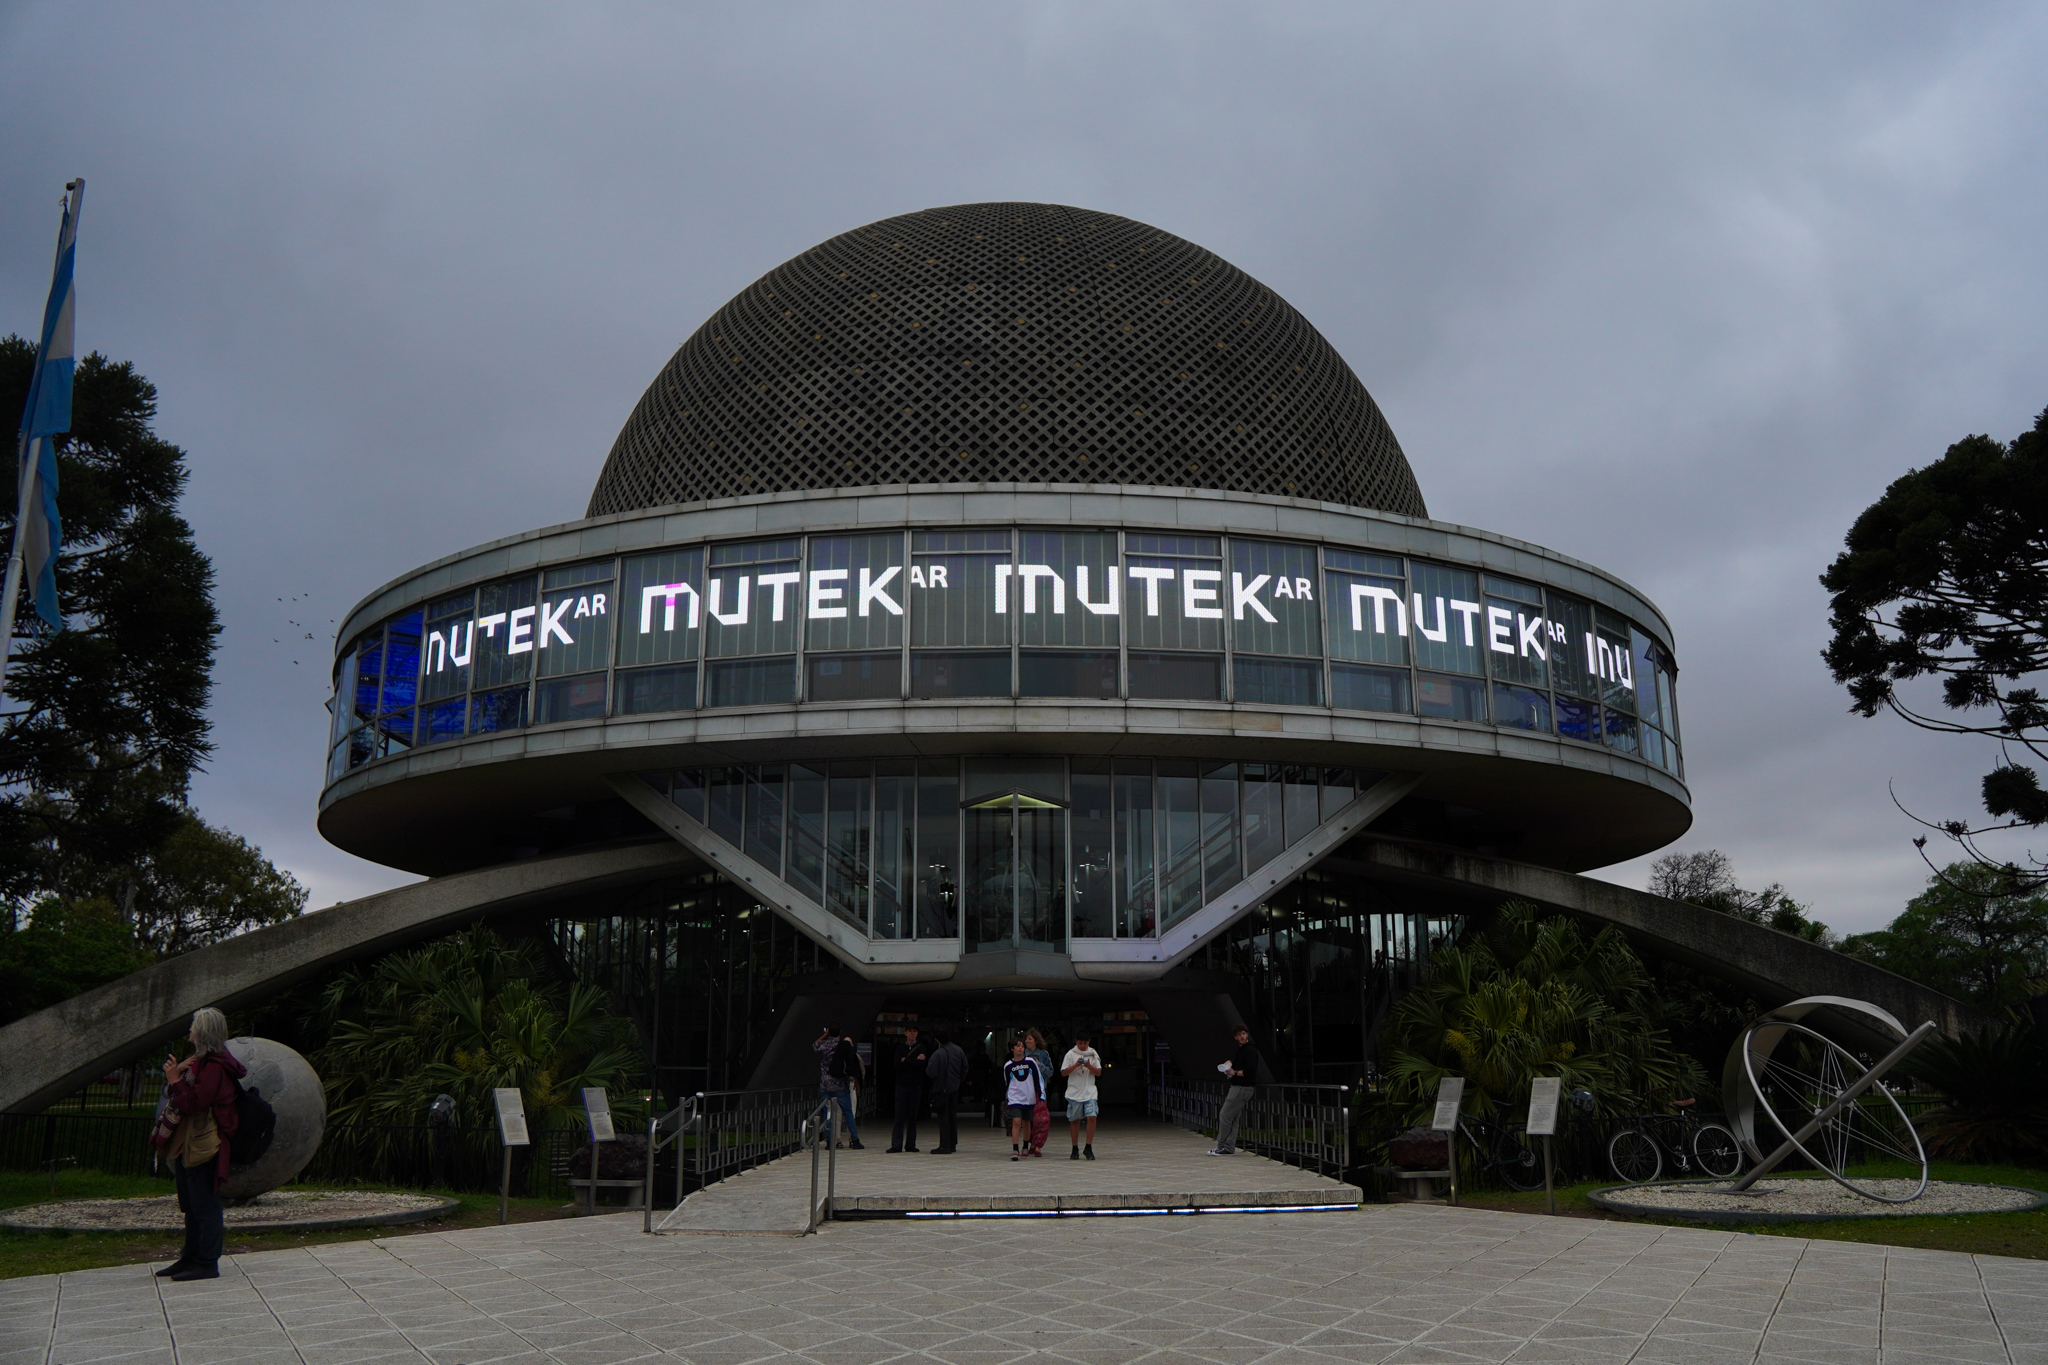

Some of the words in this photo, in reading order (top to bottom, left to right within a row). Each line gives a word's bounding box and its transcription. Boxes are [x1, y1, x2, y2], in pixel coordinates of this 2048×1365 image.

[574, 593, 606, 619] AR
[640, 566, 904, 634] MUTEK
[911, 565, 948, 588] AR
[995, 564, 1278, 623] MUTEK
[1274, 576, 1313, 601] AR
[1350, 583, 1546, 661] MUTEK
[1547, 620, 1567, 645] AR
